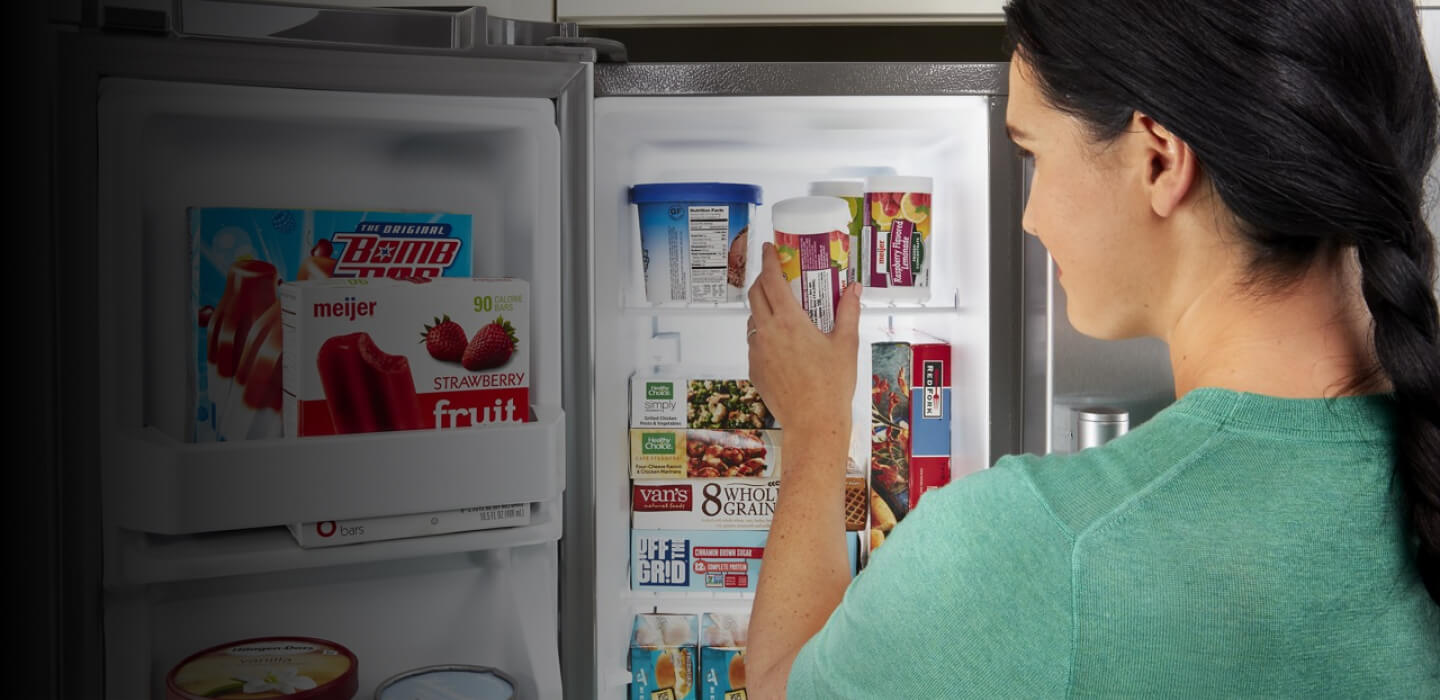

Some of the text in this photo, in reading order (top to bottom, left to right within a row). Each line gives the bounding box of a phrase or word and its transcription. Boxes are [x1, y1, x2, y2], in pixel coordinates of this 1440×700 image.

[361, 224, 445, 235] THE ORIGINAL
[334, 234, 461, 265] BOMB
[877, 239, 886, 265] meijer
[892, 220, 904, 283] Raspberry Flavored
[902, 236, 910, 270] Lemonade
[314, 297, 377, 321] meijer
[473, 295, 492, 312] 90
[433, 372, 525, 390] STRAWBERRY
[926, 365, 934, 414] RED FORK
[433, 398, 522, 428] fruit
[644, 400, 677, 412] simply
[645, 442, 673, 450] Choice
[647, 436, 672, 444] Healthy
[640, 487, 688, 502] van's
[701, 482, 722, 517] 8
[340, 525, 365, 537] bars
